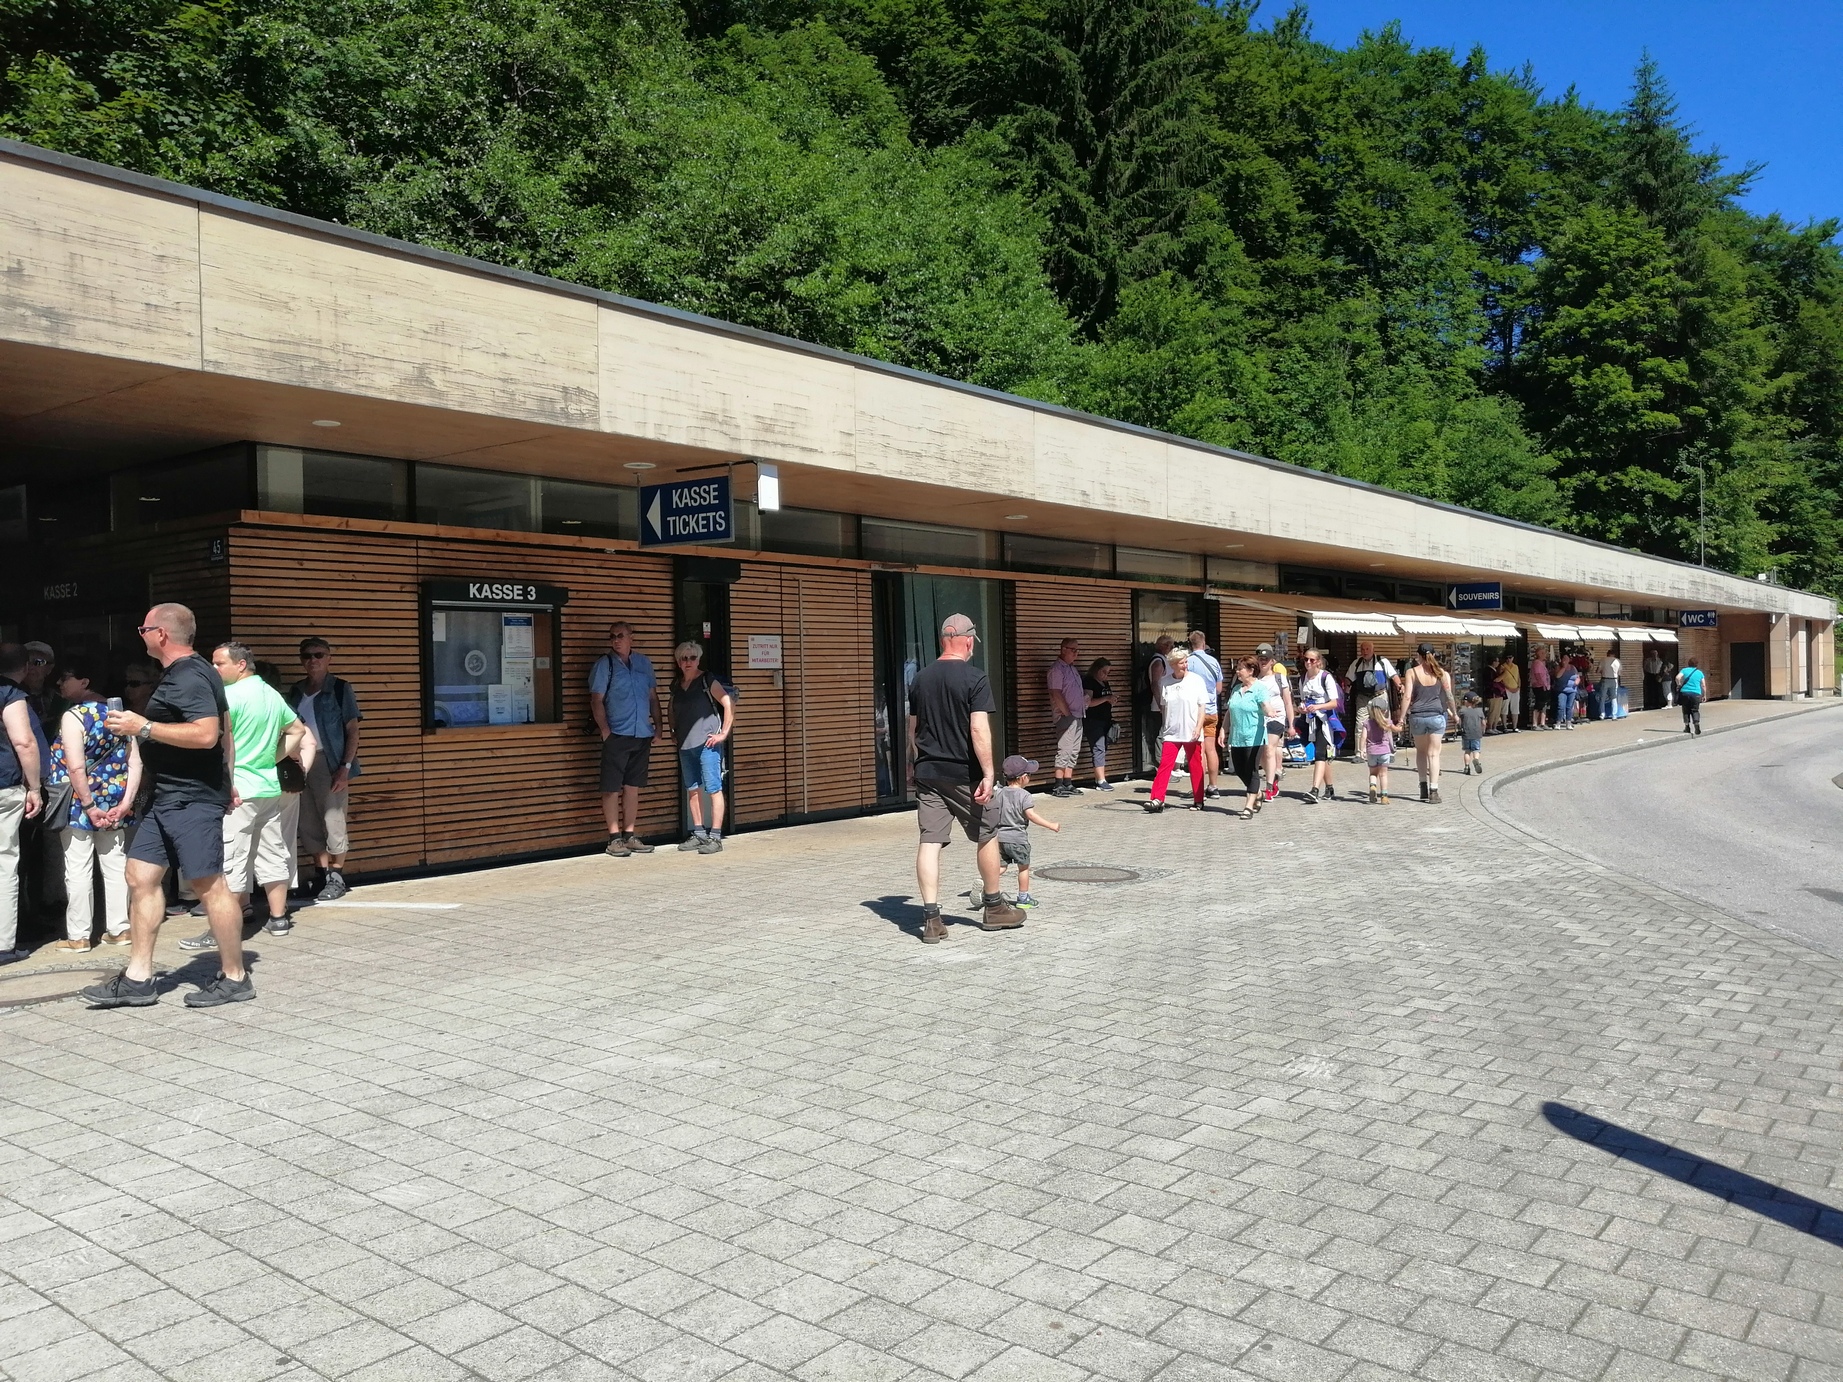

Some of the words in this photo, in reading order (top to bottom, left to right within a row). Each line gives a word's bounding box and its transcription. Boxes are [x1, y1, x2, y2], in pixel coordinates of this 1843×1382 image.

[672, 484, 719, 509] KASSE
[667, 511, 726, 536] TICKETS
[213, 540, 221, 554] 45
[44, 584, 71, 600] KASSE
[73, 582, 78, 597] 2
[469, 583, 523, 600] KASSE
[527, 586, 536, 600] 3
[1458, 592, 1500, 601] SOUVENIRS
[1687, 614, 1705, 624] WC
